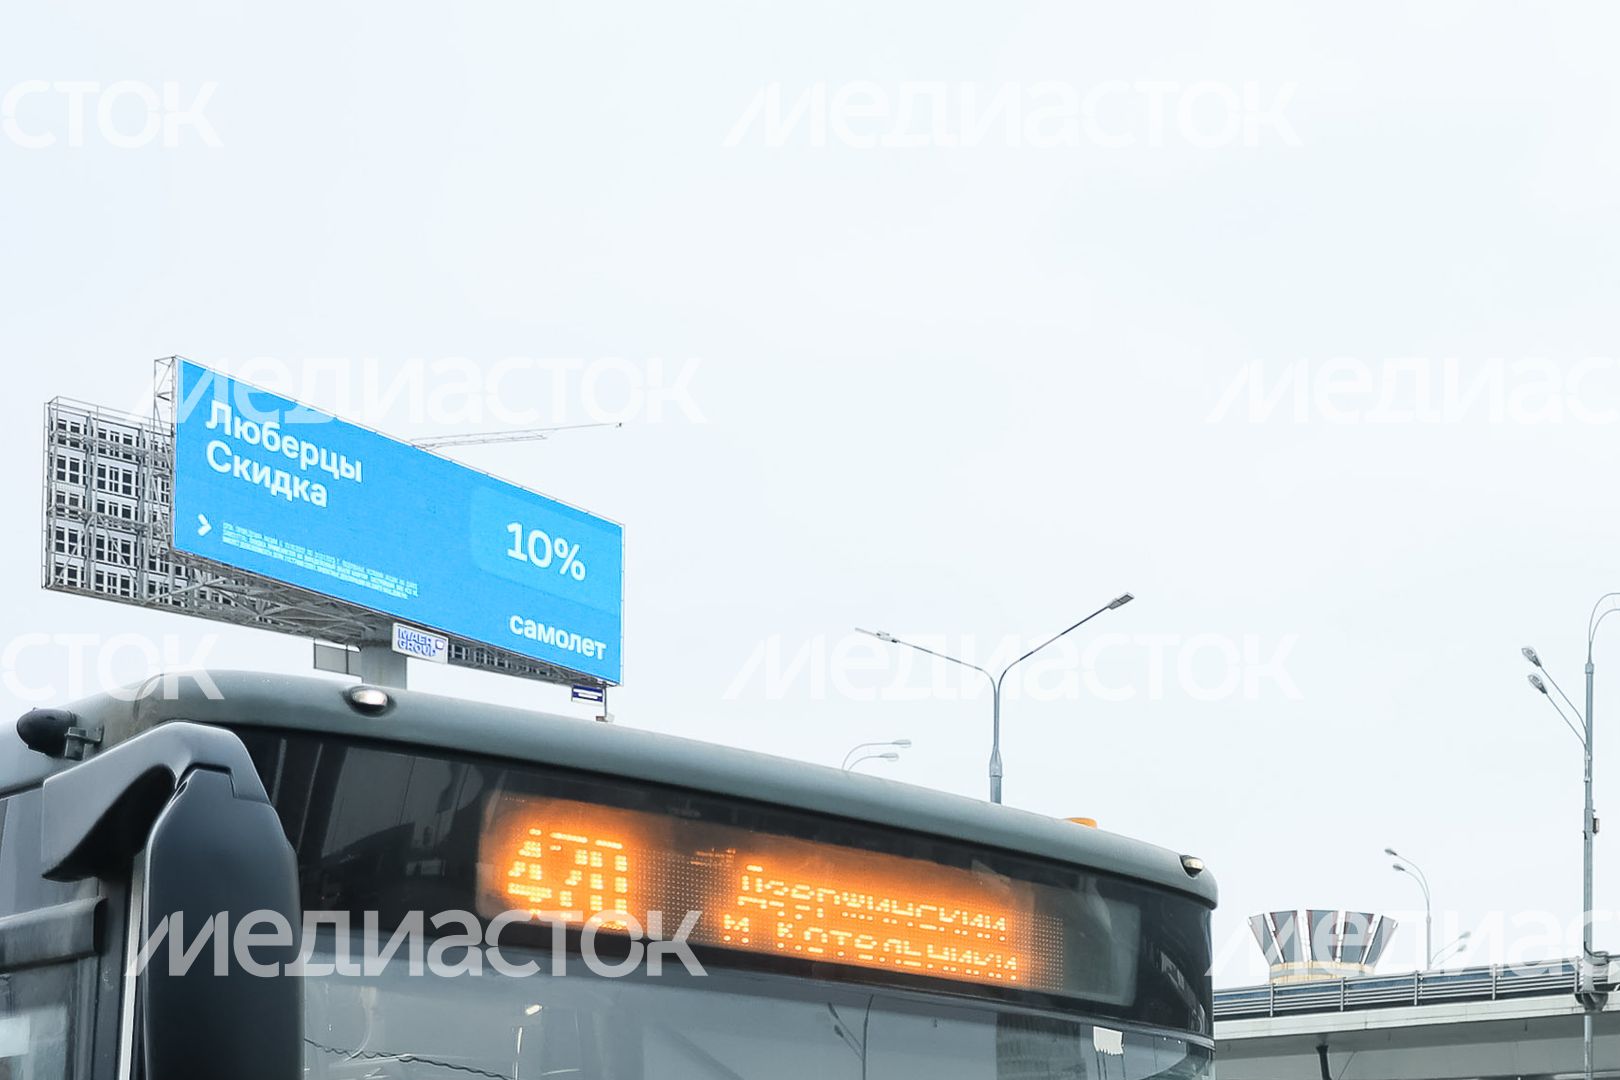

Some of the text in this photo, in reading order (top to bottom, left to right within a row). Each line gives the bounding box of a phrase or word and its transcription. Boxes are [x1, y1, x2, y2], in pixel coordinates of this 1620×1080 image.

[205, 399, 363, 483] Люберцы
[205, 440, 328, 507] Скидка
[505, 520, 586, 581] 10%
[397, 639, 437, 657] GROUP
[509, 615, 606, 660] самолет
[507, 828, 629, 930] 470
